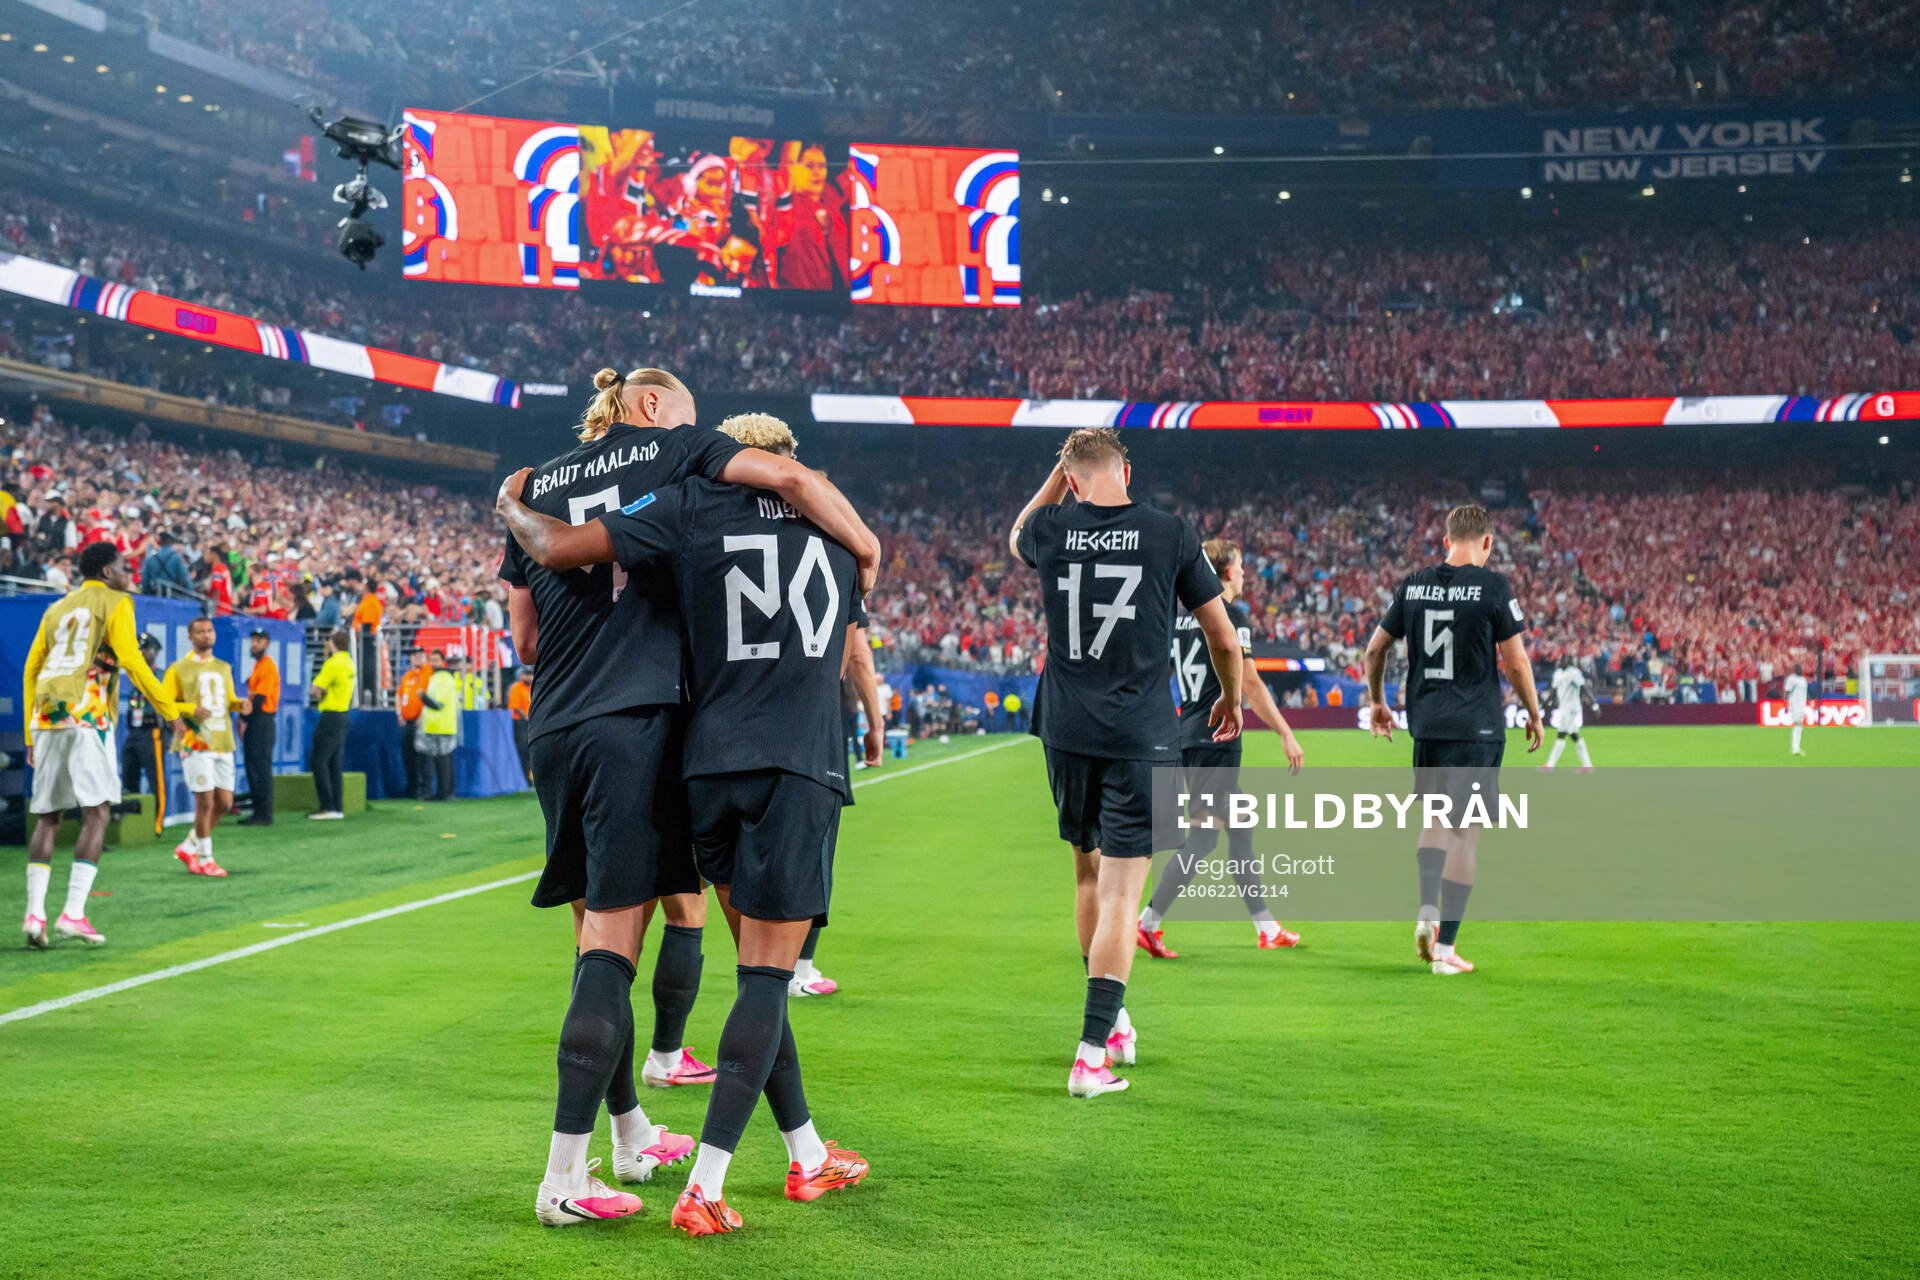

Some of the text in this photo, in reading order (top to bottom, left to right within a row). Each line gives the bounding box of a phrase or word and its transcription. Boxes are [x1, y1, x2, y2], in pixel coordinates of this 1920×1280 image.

[1543, 117, 1827, 153] NEW YORK
[1545, 151, 1826, 182] NEW JERSEY
[531, 440, 661, 500] BRAUT HAALAND
[756, 496, 802, 520] NUS
[1065, 529, 1140, 551] HEGGEM
[723, 534, 841, 662] 20
[1057, 562, 1144, 661] 17
[1405, 584, 1483, 602] MØLLER WOLFE
[1423, 608, 1455, 681] 5
[1169, 636, 1208, 703] 16
